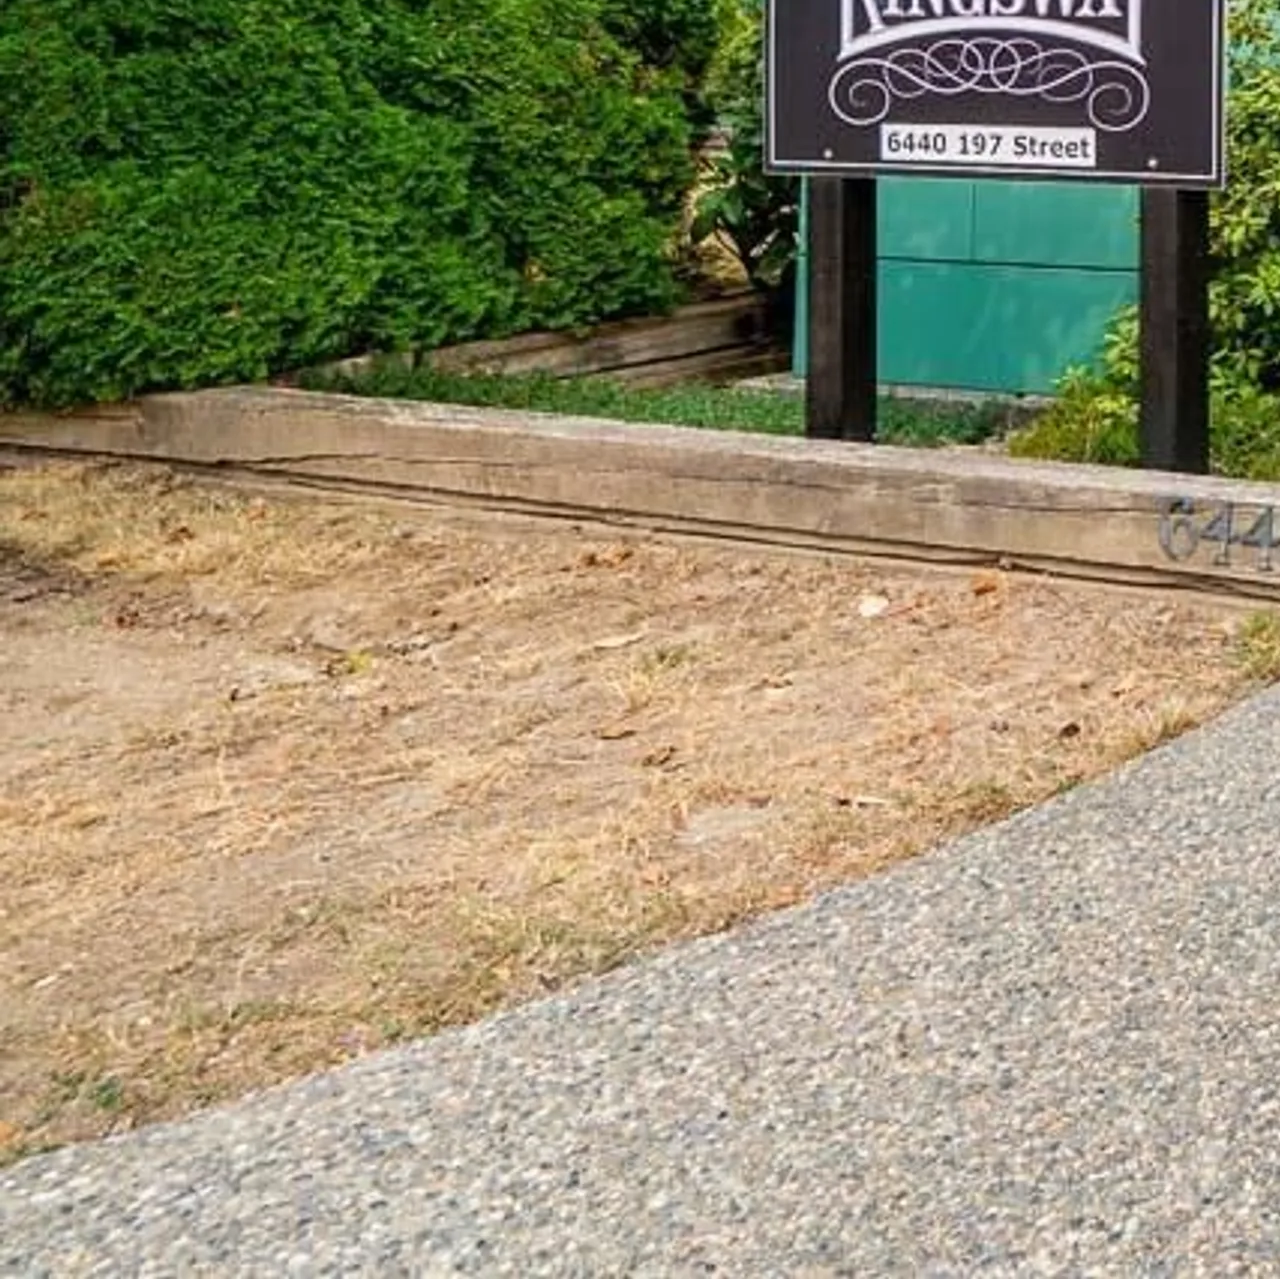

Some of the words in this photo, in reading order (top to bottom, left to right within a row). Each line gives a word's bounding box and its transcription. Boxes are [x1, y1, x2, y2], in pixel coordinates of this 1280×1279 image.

[887, 132, 947, 155] 6440
[958, 132, 1002, 157] 197
[1013, 135, 1091, 159] Street
